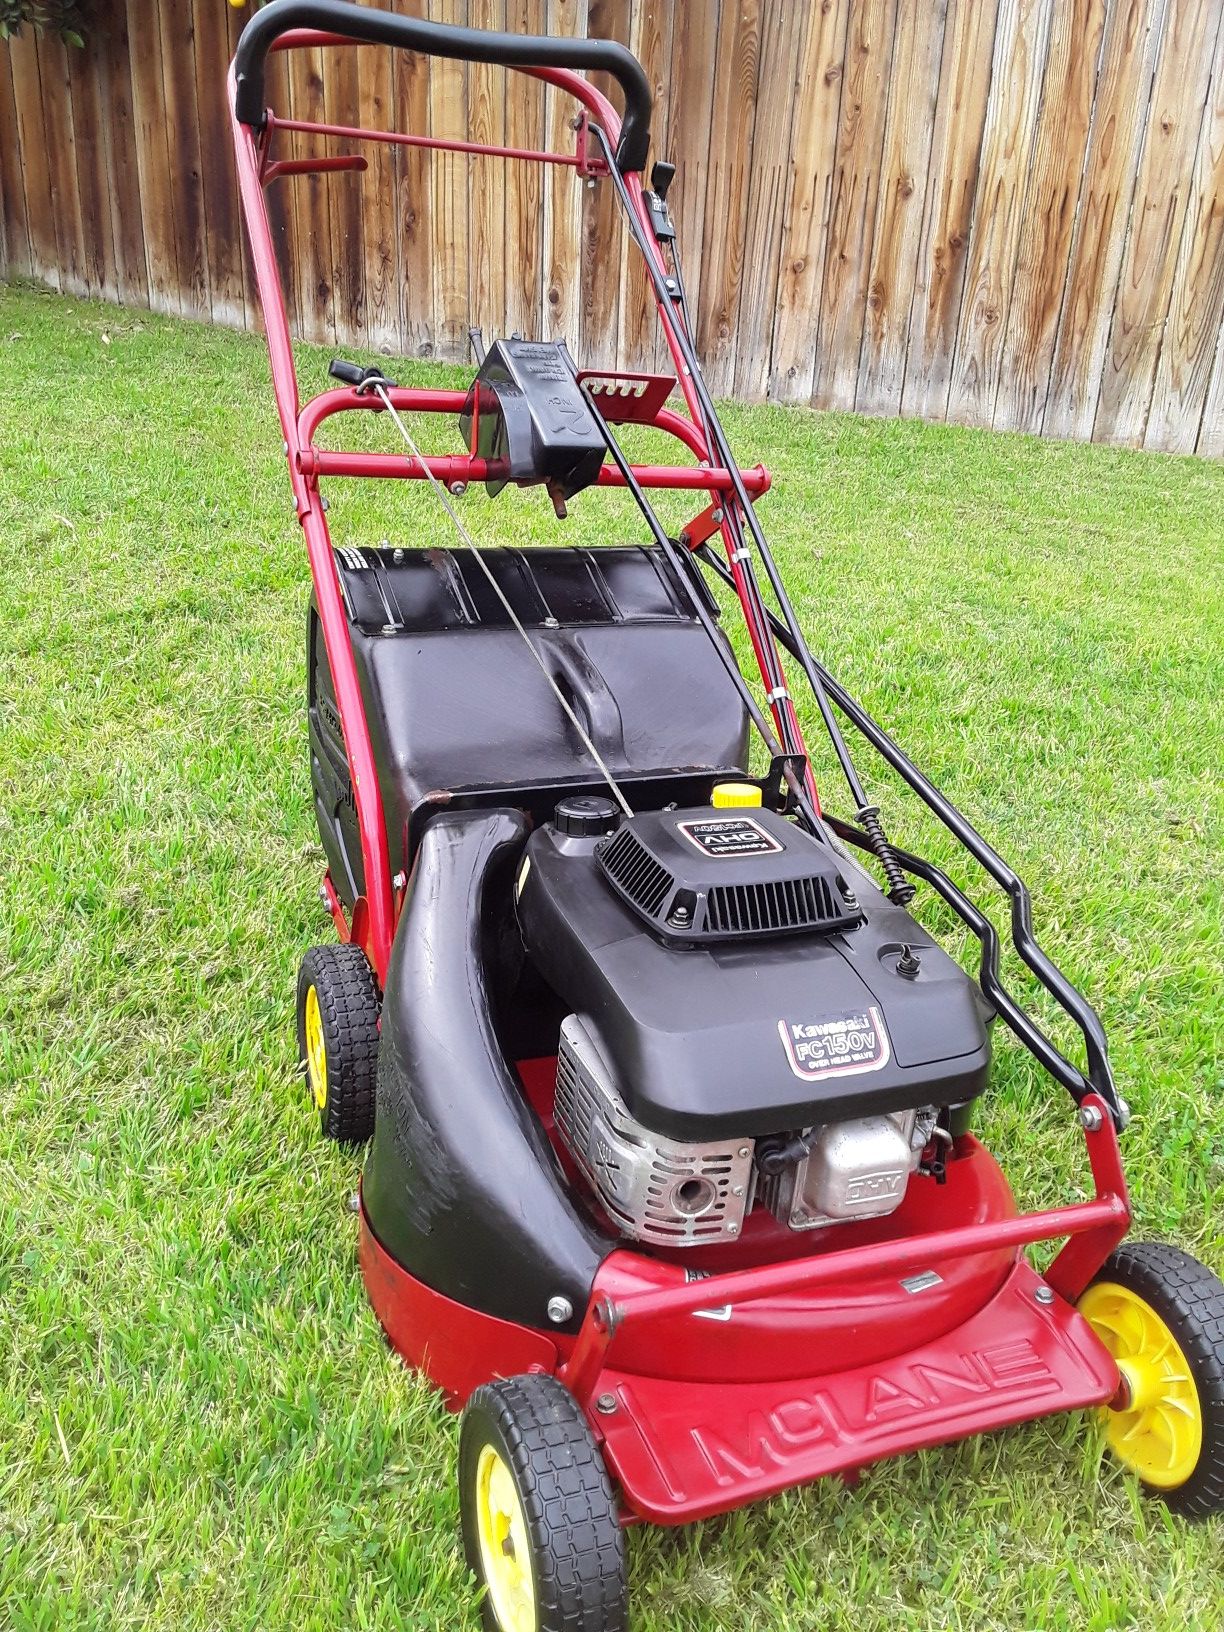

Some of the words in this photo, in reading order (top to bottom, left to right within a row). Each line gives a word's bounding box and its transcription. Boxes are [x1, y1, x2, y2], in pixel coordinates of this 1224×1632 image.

[704, 832, 760, 844] OHV
[711, 843, 768, 853] Kawasaki
[792, 1014, 871, 1039] Kawasaki
[796, 1031, 875, 1061] FC150V
[808, 1058, 831, 1069] OVER
[831, 1054, 852, 1065] HEAD
[851, 1051, 875, 1061] VALVE
